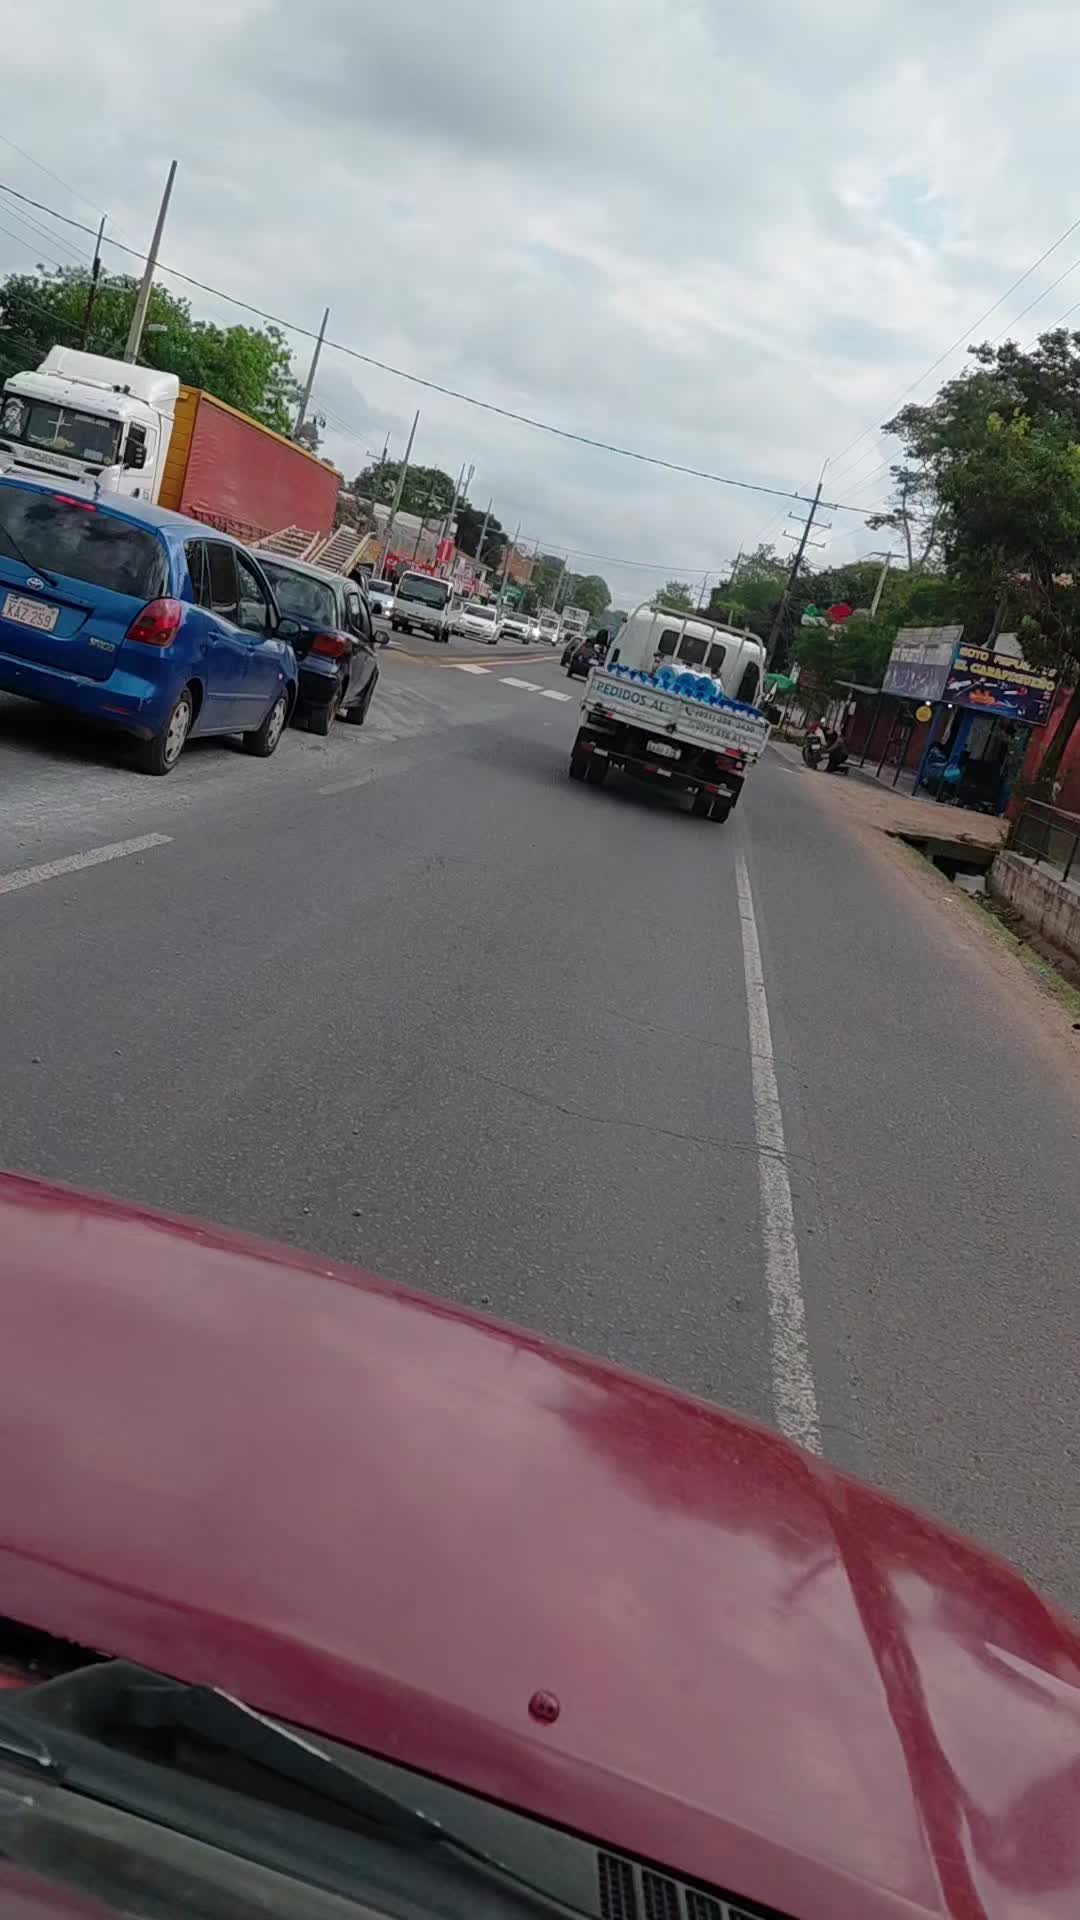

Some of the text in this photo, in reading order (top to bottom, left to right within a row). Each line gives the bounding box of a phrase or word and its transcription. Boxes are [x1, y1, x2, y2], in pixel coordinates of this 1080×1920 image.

[7, 603, 28, 620] KAZ
[30, 610, 52, 628] 259
[596, 680, 647, 706] PEDIDOS
